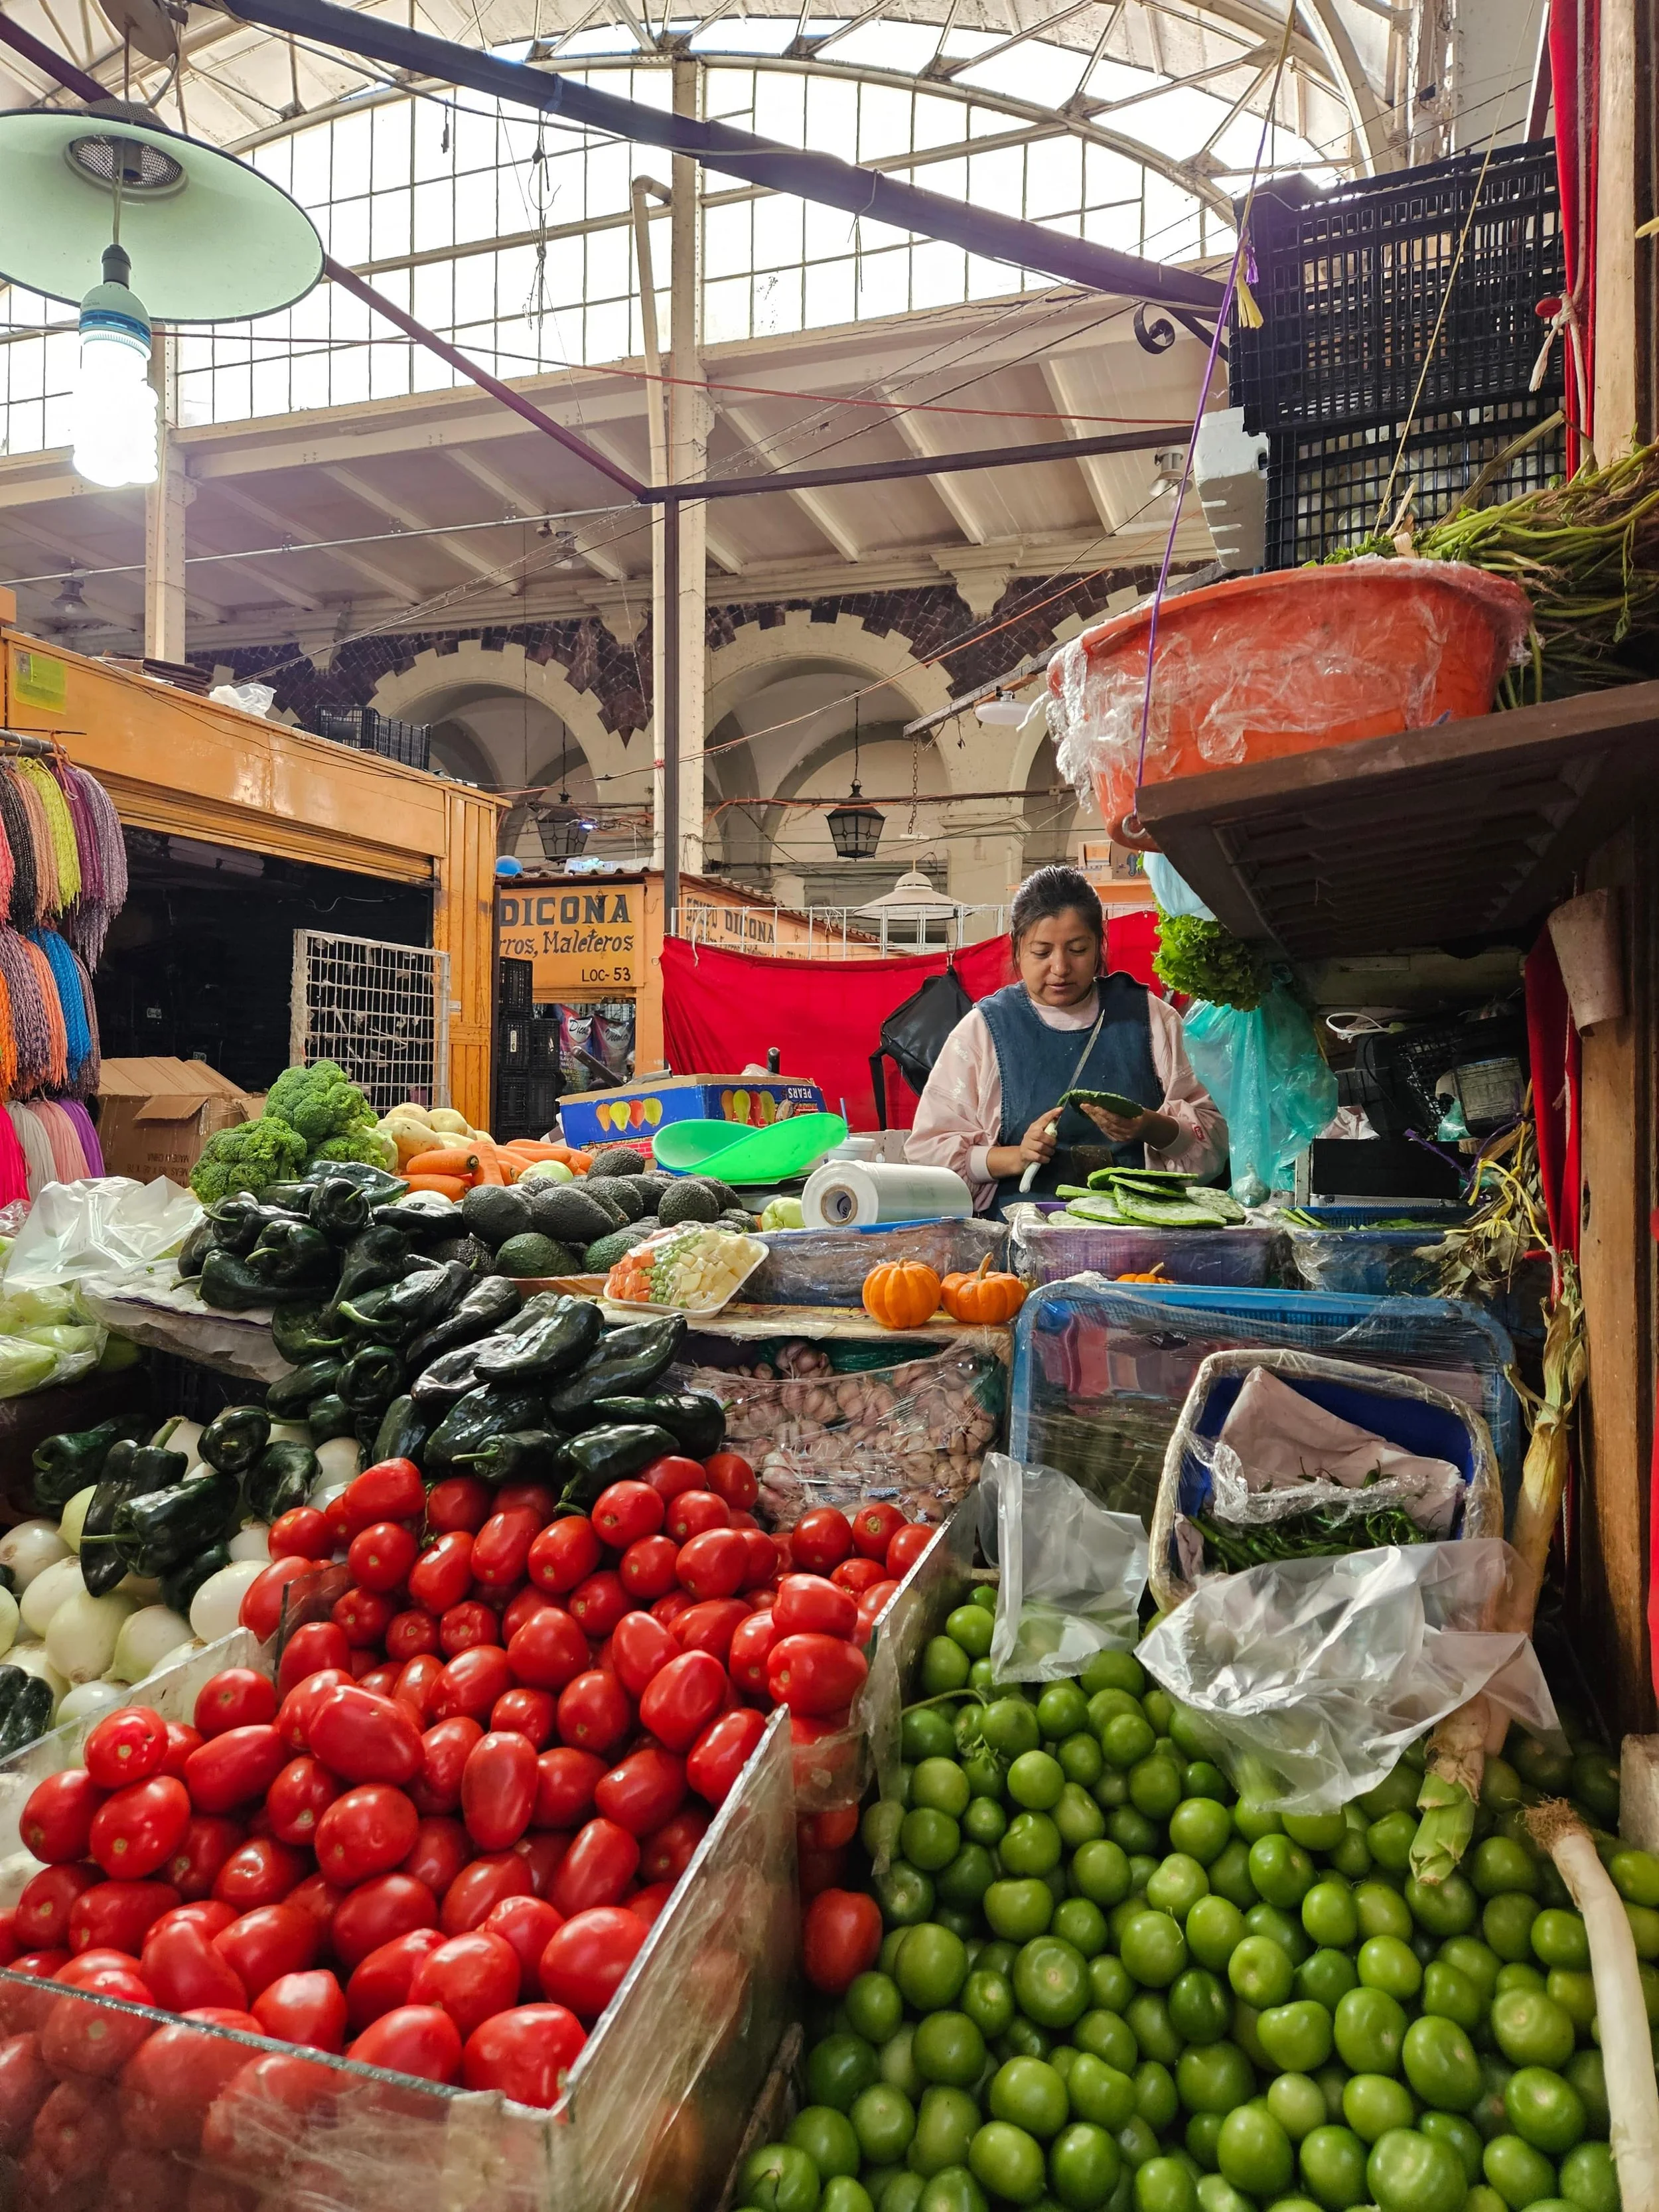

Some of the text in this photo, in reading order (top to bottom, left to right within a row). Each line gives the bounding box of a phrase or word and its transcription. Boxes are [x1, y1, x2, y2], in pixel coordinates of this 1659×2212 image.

[500, 895, 632, 927] DICONA
[725, 909, 774, 943] DICONA
[543, 929, 634, 954] Maleteros
[613, 967, 631, 981] 53
[788, 1087, 812, 1098] PEARS
